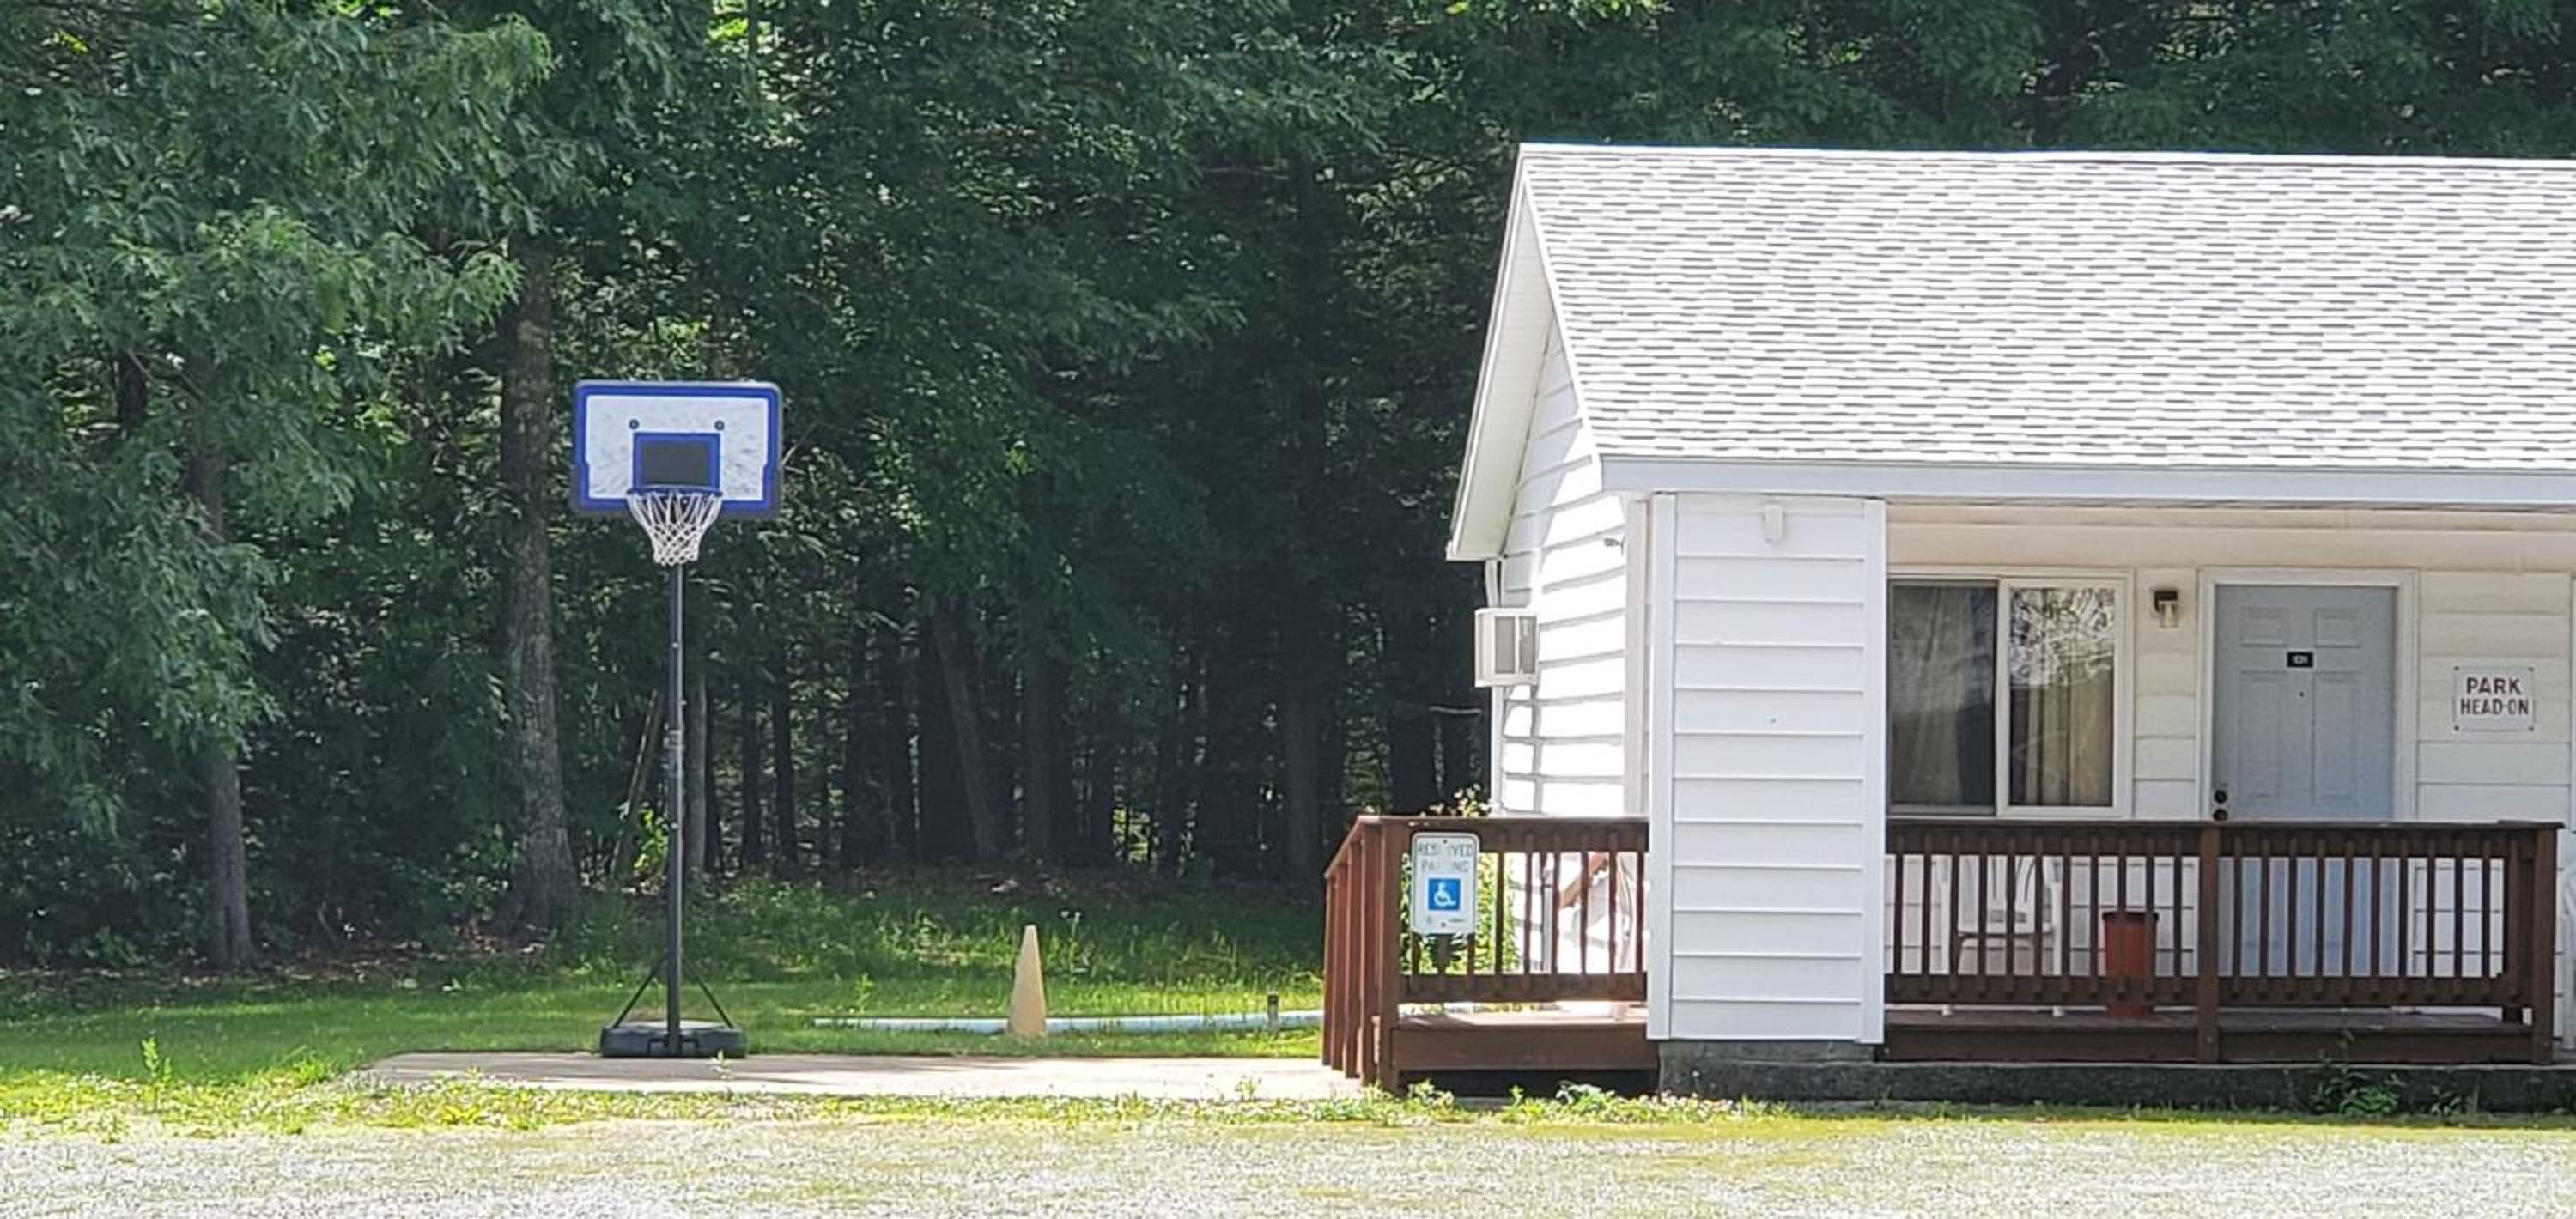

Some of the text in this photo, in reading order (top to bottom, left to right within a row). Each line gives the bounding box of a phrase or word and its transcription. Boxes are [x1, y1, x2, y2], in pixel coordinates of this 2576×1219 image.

[2466, 677, 2522, 694] PARK
[2460, 699, 2529, 714] HEAD-ON
[1418, 844, 1473, 857] RESVED
